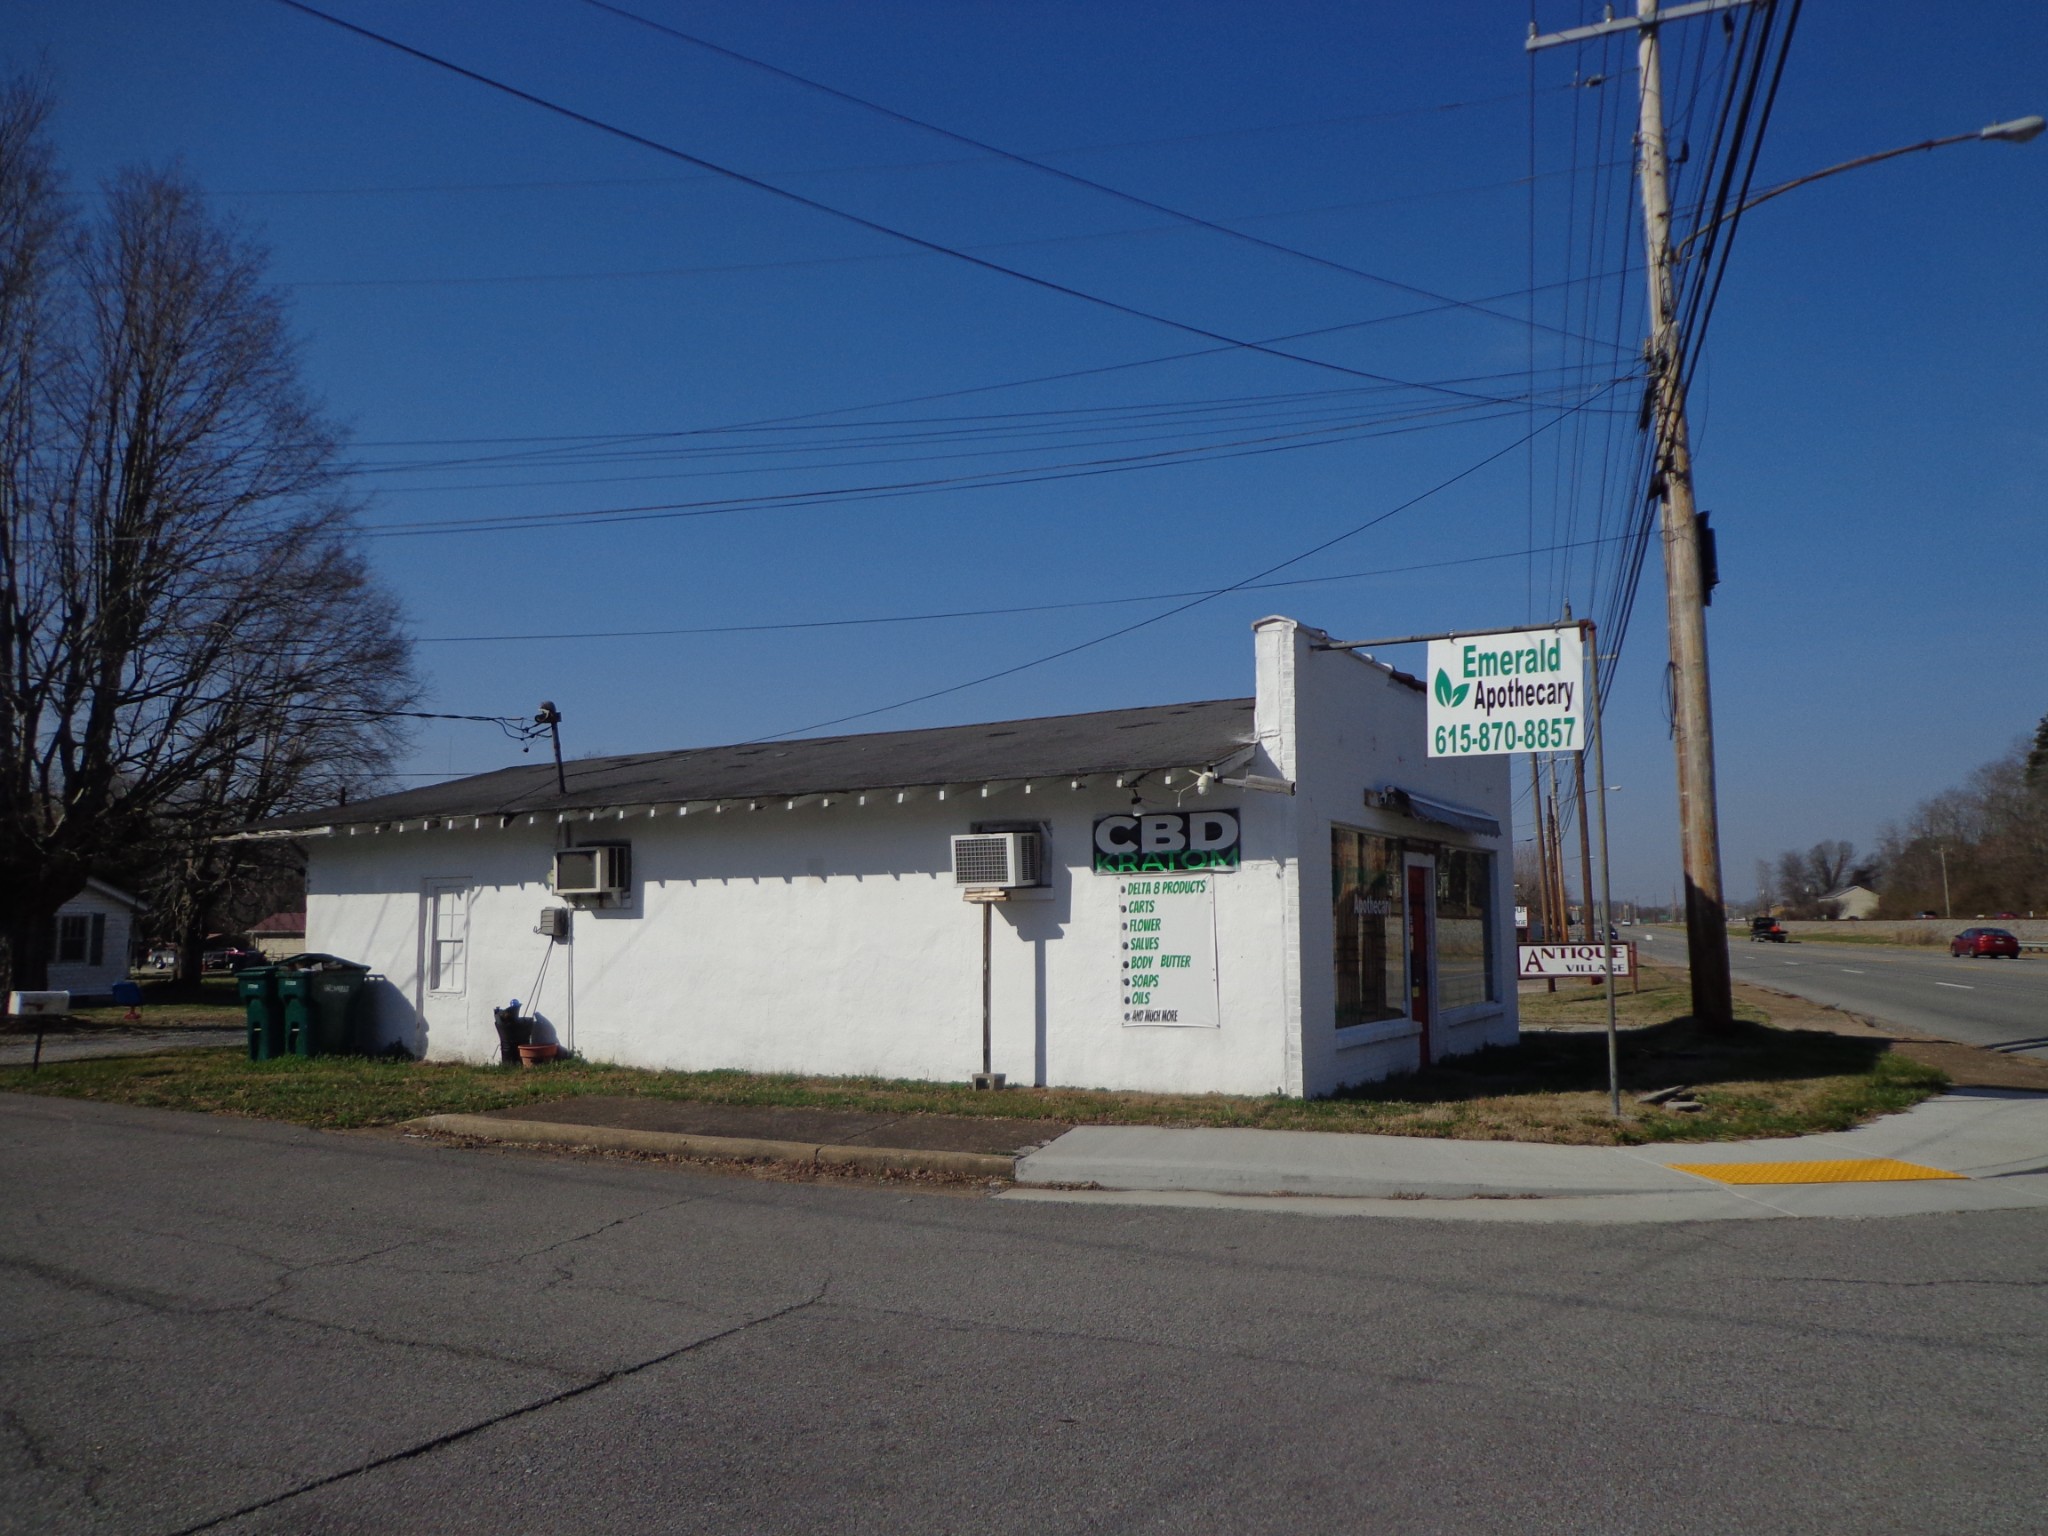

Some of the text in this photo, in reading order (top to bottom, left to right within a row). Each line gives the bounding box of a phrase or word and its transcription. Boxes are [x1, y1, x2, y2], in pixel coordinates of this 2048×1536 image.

[1463, 637, 1561, 679] Emerald
[1474, 677, 1575, 717] Apothecary
[1435, 716, 1576, 755] 615-870-8857
[1095, 811, 1239, 855] CBD
[1096, 847, 1239, 873] KRATOM
[1128, 879, 1206, 895] DELTA 8 PRODUCTS
[1128, 900, 1155, 914] CARTS
[1129, 918, 1161, 932] FLOWER
[1130, 937, 1160, 951] SALVES
[1131, 954, 1192, 969] BODY BUTTER
[1523, 946, 1625, 973] ANTIQUE
[1131, 974, 1160, 988] SOAPS
[1132, 991, 1151, 1005] OILS
[1131, 1009, 1179, 1022] AND MUCH MORE
